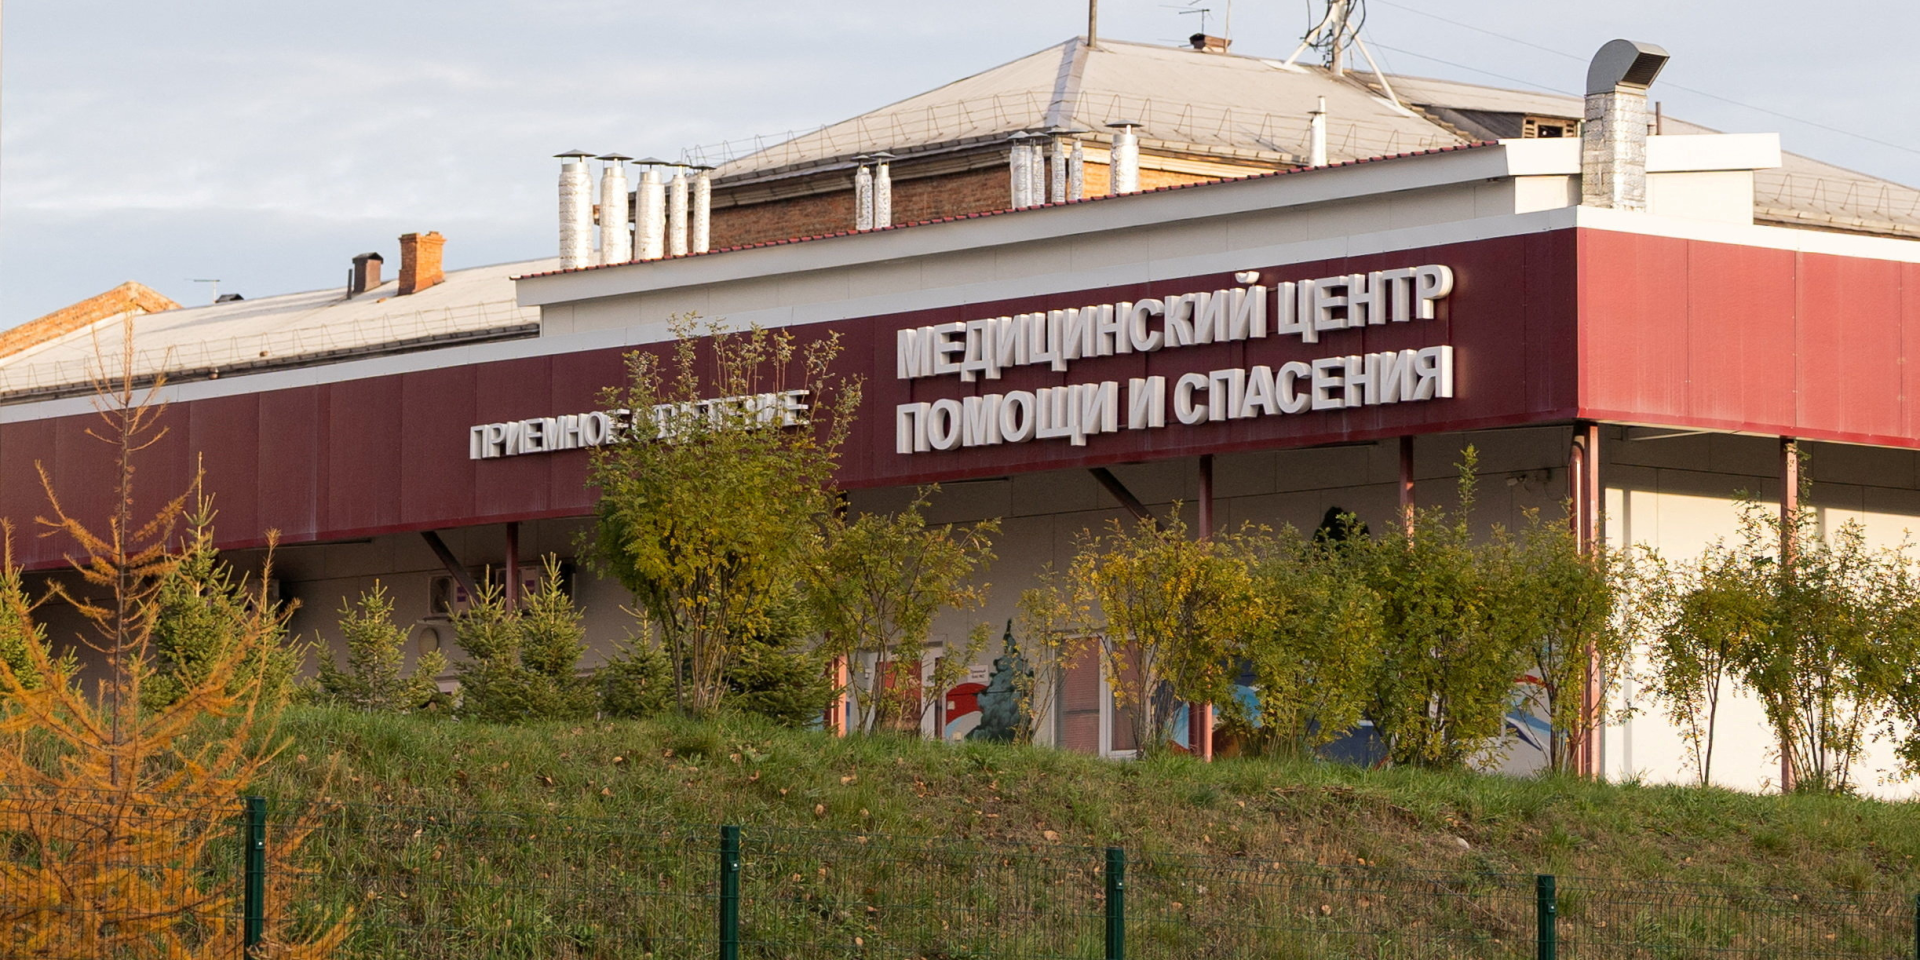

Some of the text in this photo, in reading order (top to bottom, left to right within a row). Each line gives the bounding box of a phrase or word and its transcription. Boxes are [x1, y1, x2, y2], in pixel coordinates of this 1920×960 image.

[897, 265, 1453, 382] МЕДИЦИНСКИЙ ЦЕНТР
[469, 408, 630, 459] ПРИЕМНОЕ
[896, 345, 1453, 454] ПОМОЩИ И СПАСЕНИЯ
